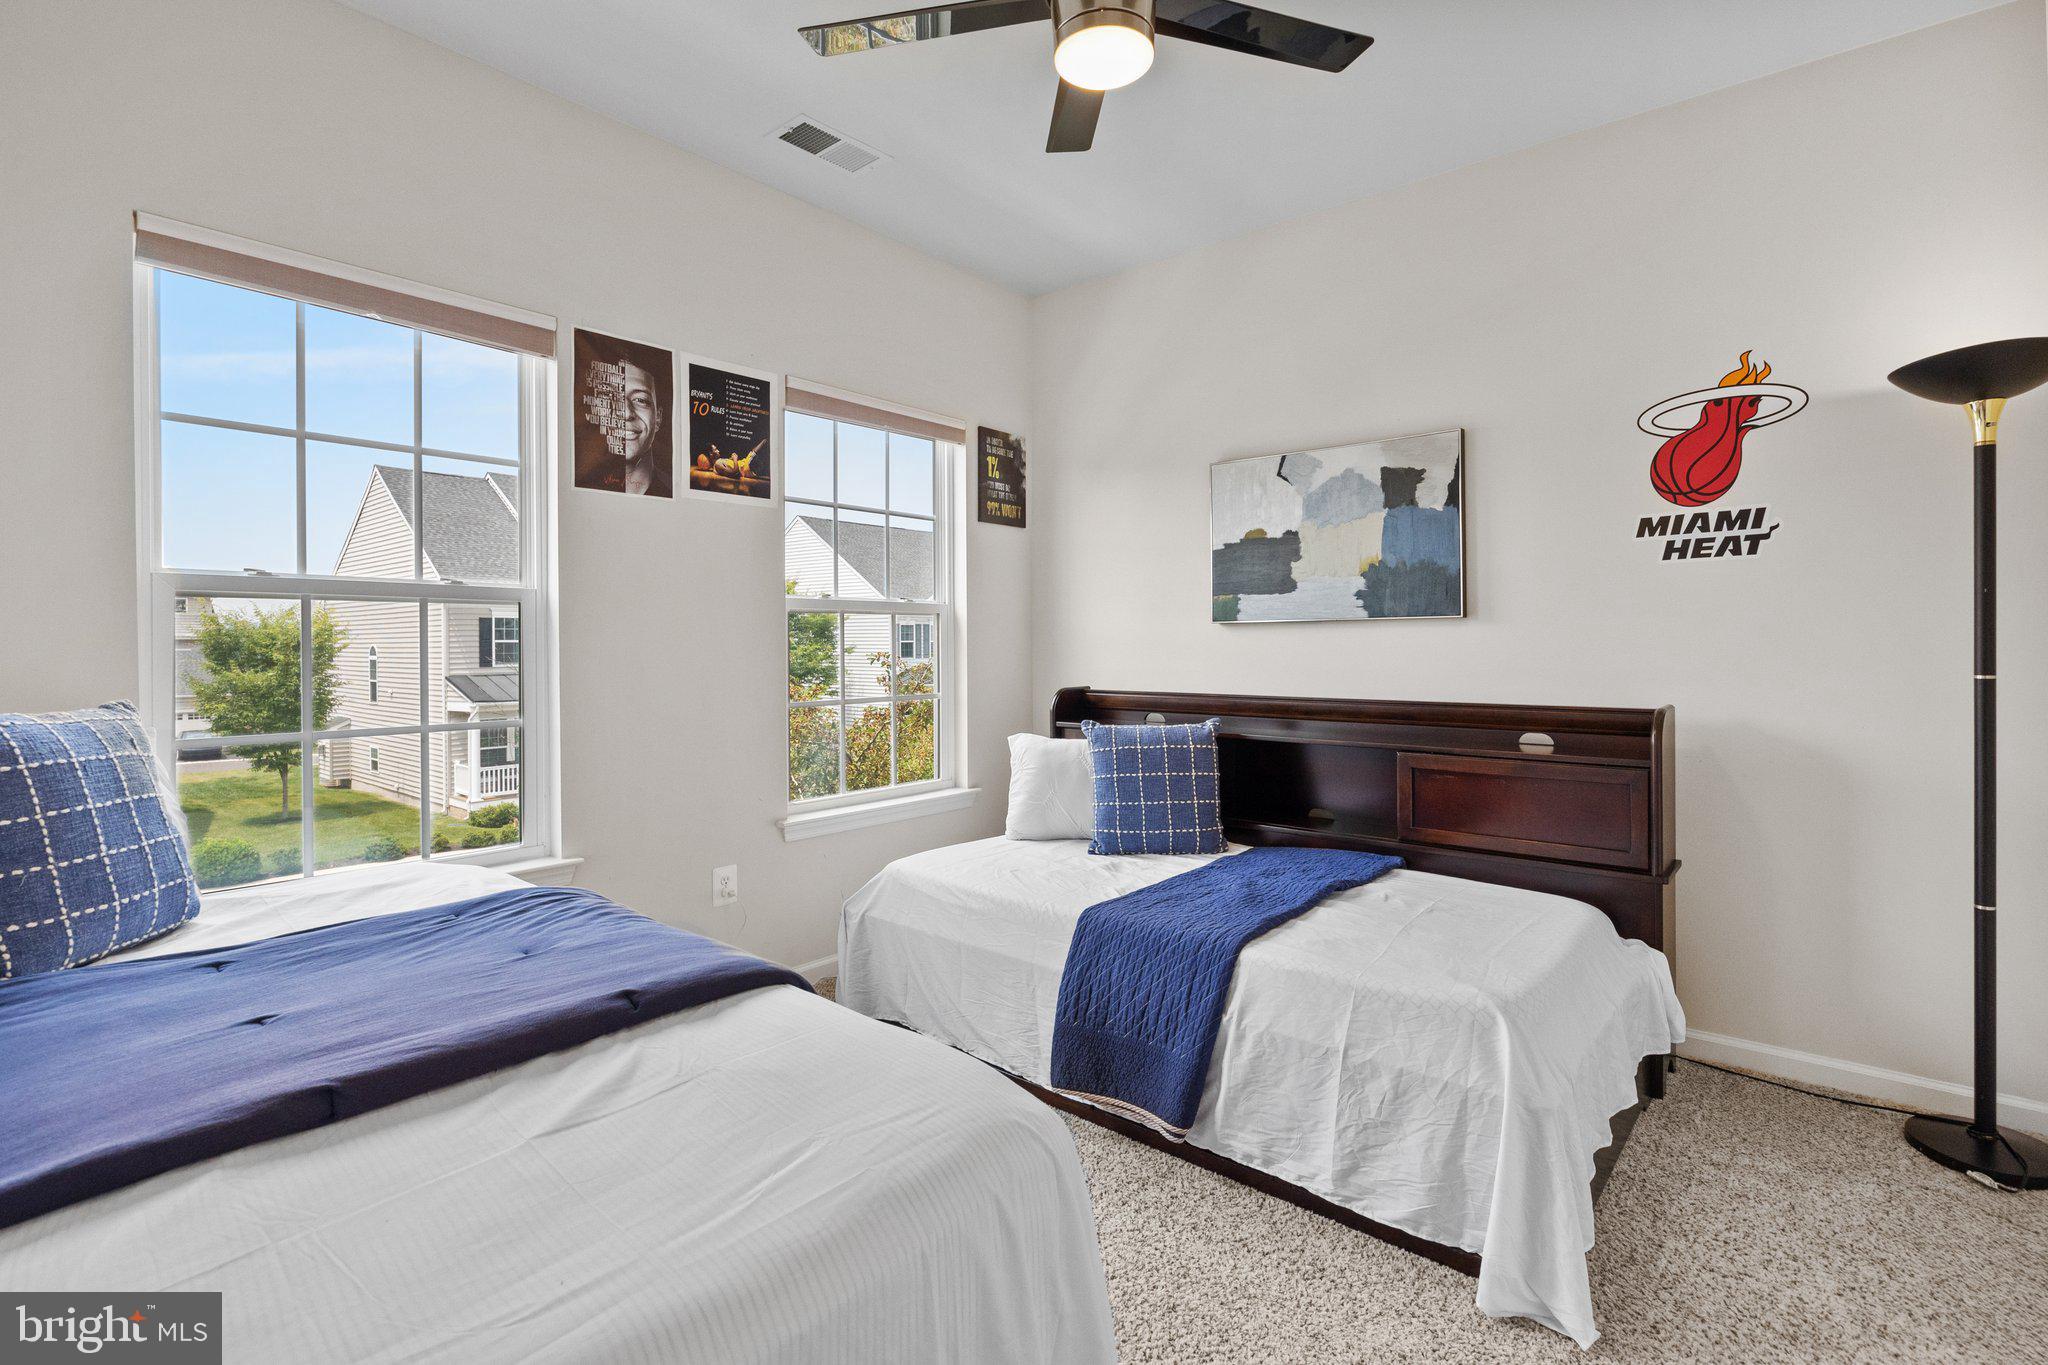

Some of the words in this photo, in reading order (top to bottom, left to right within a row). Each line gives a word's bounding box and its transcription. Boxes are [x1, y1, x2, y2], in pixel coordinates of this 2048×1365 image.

[693, 401, 710, 416] 10
[711, 405, 725, 415] RULES
[600, 416, 626, 429] BELIEVE
[986, 455, 1000, 479] 1%
[1635, 507, 1767, 538] MIAMI
[1662, 523, 1780, 561] HEAT
